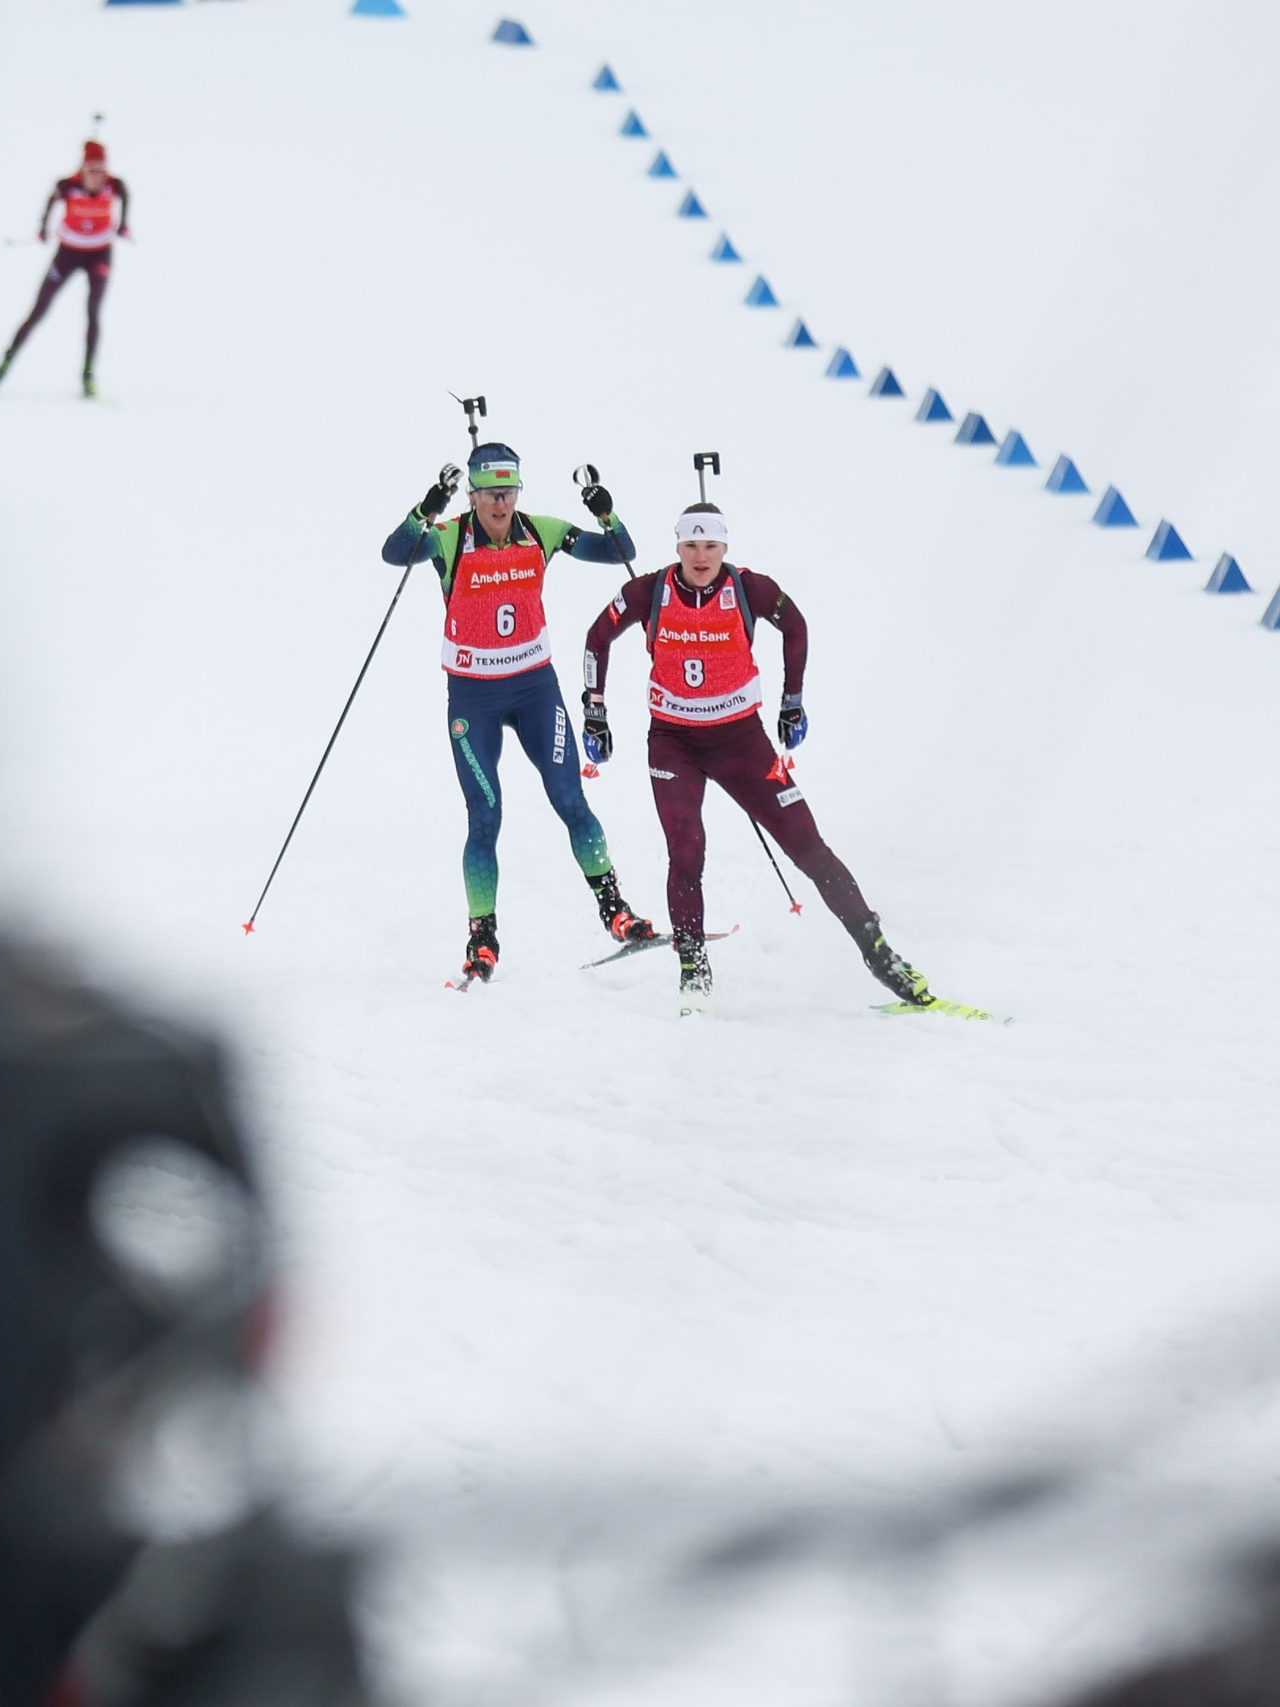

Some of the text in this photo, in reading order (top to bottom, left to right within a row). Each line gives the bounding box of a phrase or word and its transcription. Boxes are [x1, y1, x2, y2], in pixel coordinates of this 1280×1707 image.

[470, 568, 536, 588] Альфа Банк
[496, 602, 517, 638] 6
[659, 626, 730, 643] Альфа Банк
[682, 658, 706, 689] 8
[665, 695, 747, 713] ТЕХНОНИКОЛЬ
